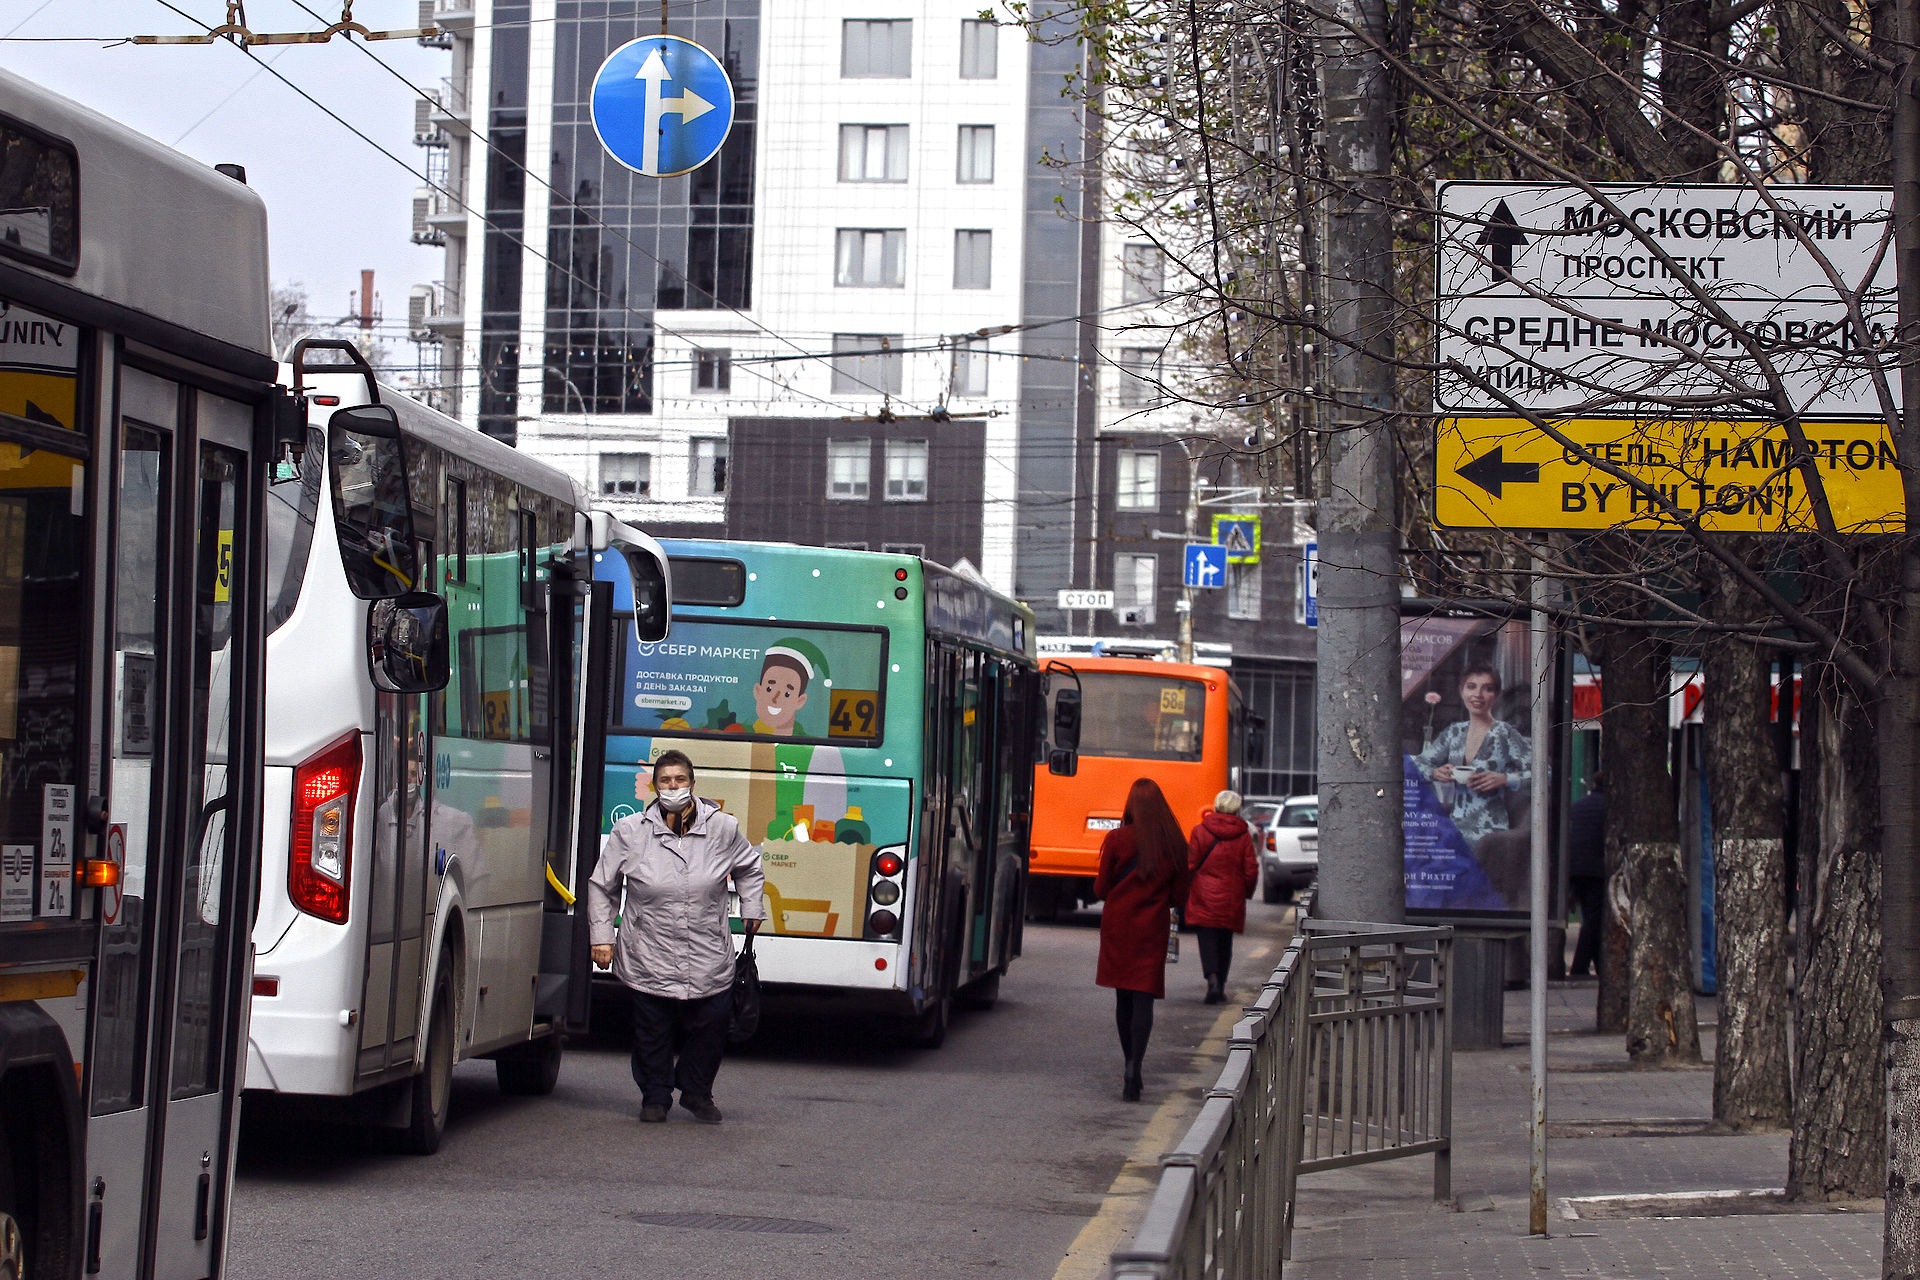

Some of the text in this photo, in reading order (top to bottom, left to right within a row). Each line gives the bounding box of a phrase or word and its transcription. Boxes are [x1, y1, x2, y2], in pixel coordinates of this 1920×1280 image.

[1563, 203, 1852, 240] МОСКОВСКИЙ
[1563, 255, 1725, 279] ПРОСПЕКТ
[1563, 443, 1666, 466] ОТЕЛЬ
[1562, 482, 1616, 512] BY
[1066, 593, 1106, 606] СТОП
[1416, 634, 1453, 645] ЧАСОВ
[658, 643, 760, 660] СБЕР МАРКЕТ
[636, 670, 739, 684] ДОСТАВКА ПРОДУКТОВ
[643, 683, 667, 691] ДЕНЬ
[668, 683, 707, 693] ЗАКАЗА!
[641, 697, 687, 706] sbermarket.ru
[830, 698, 874, 732] 49
